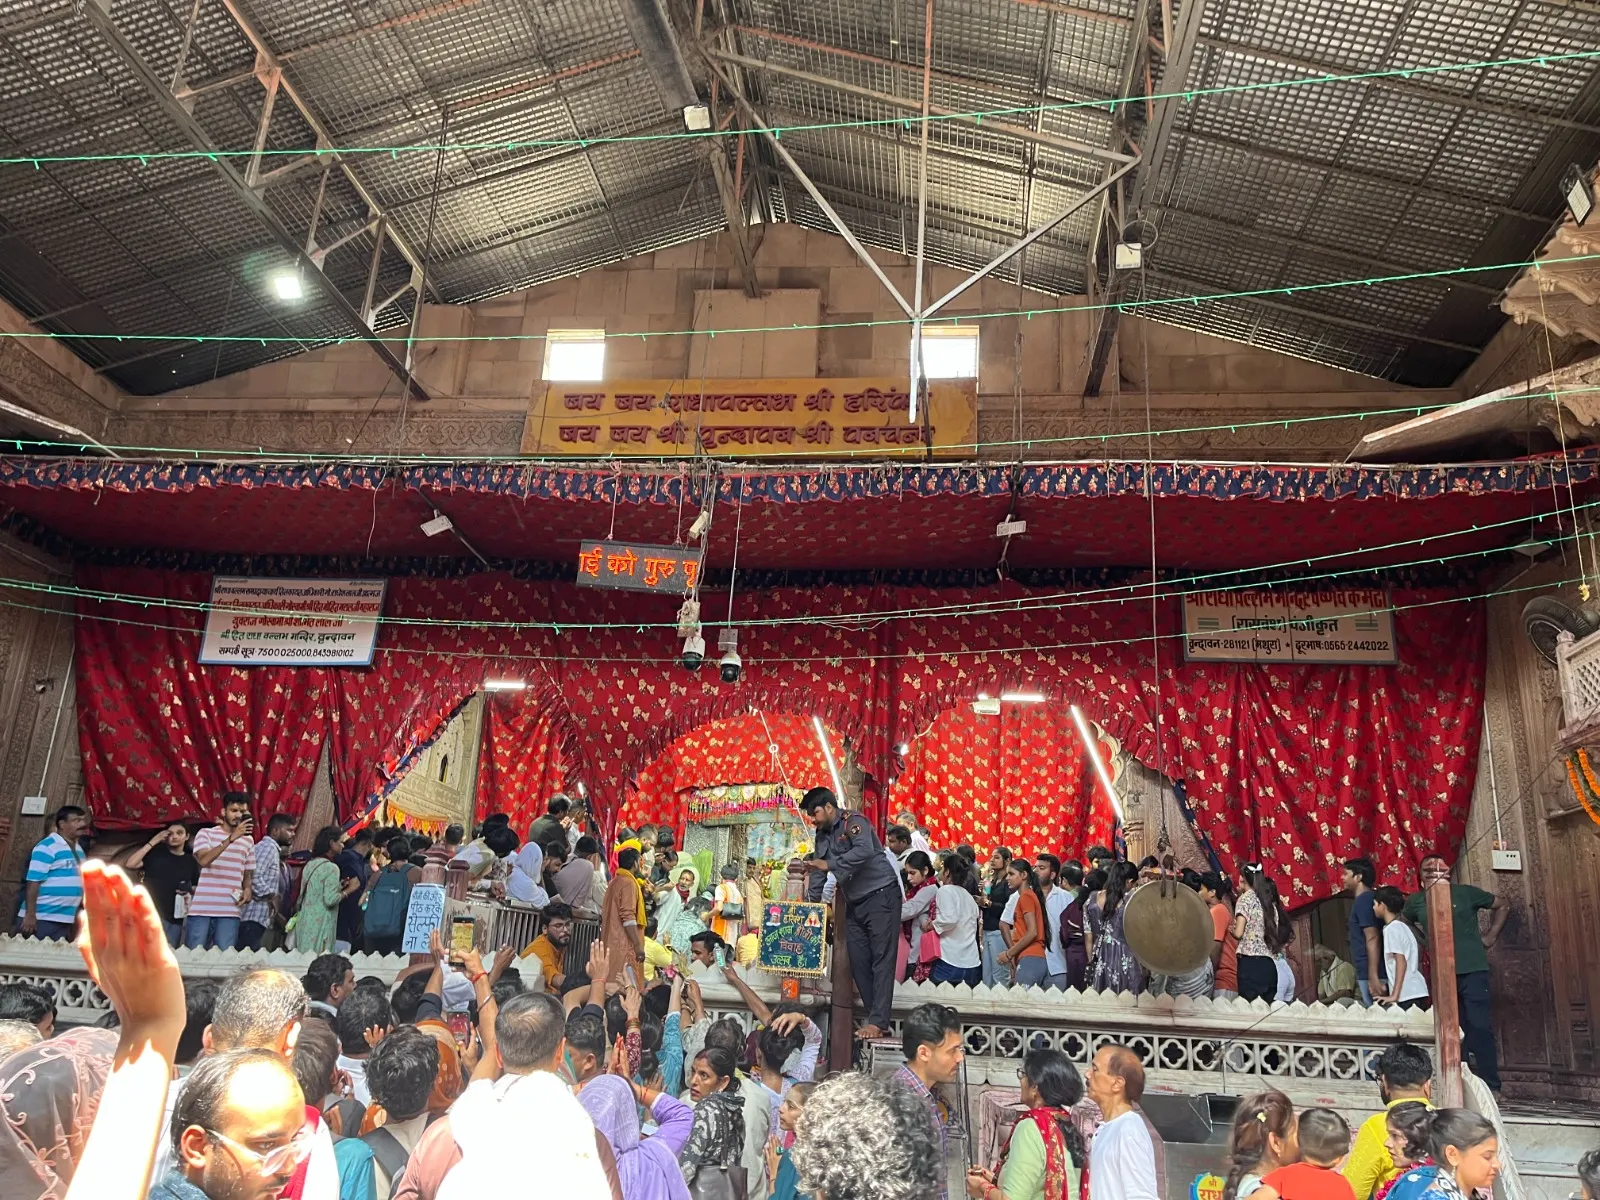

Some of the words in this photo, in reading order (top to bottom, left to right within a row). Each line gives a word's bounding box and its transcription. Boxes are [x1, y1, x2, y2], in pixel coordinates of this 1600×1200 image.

[804, 387, 834, 412] श्री
[802, 420, 834, 444] श्री
[607, 549, 638, 576] को
[411, 901, 424, 913] पीठ
